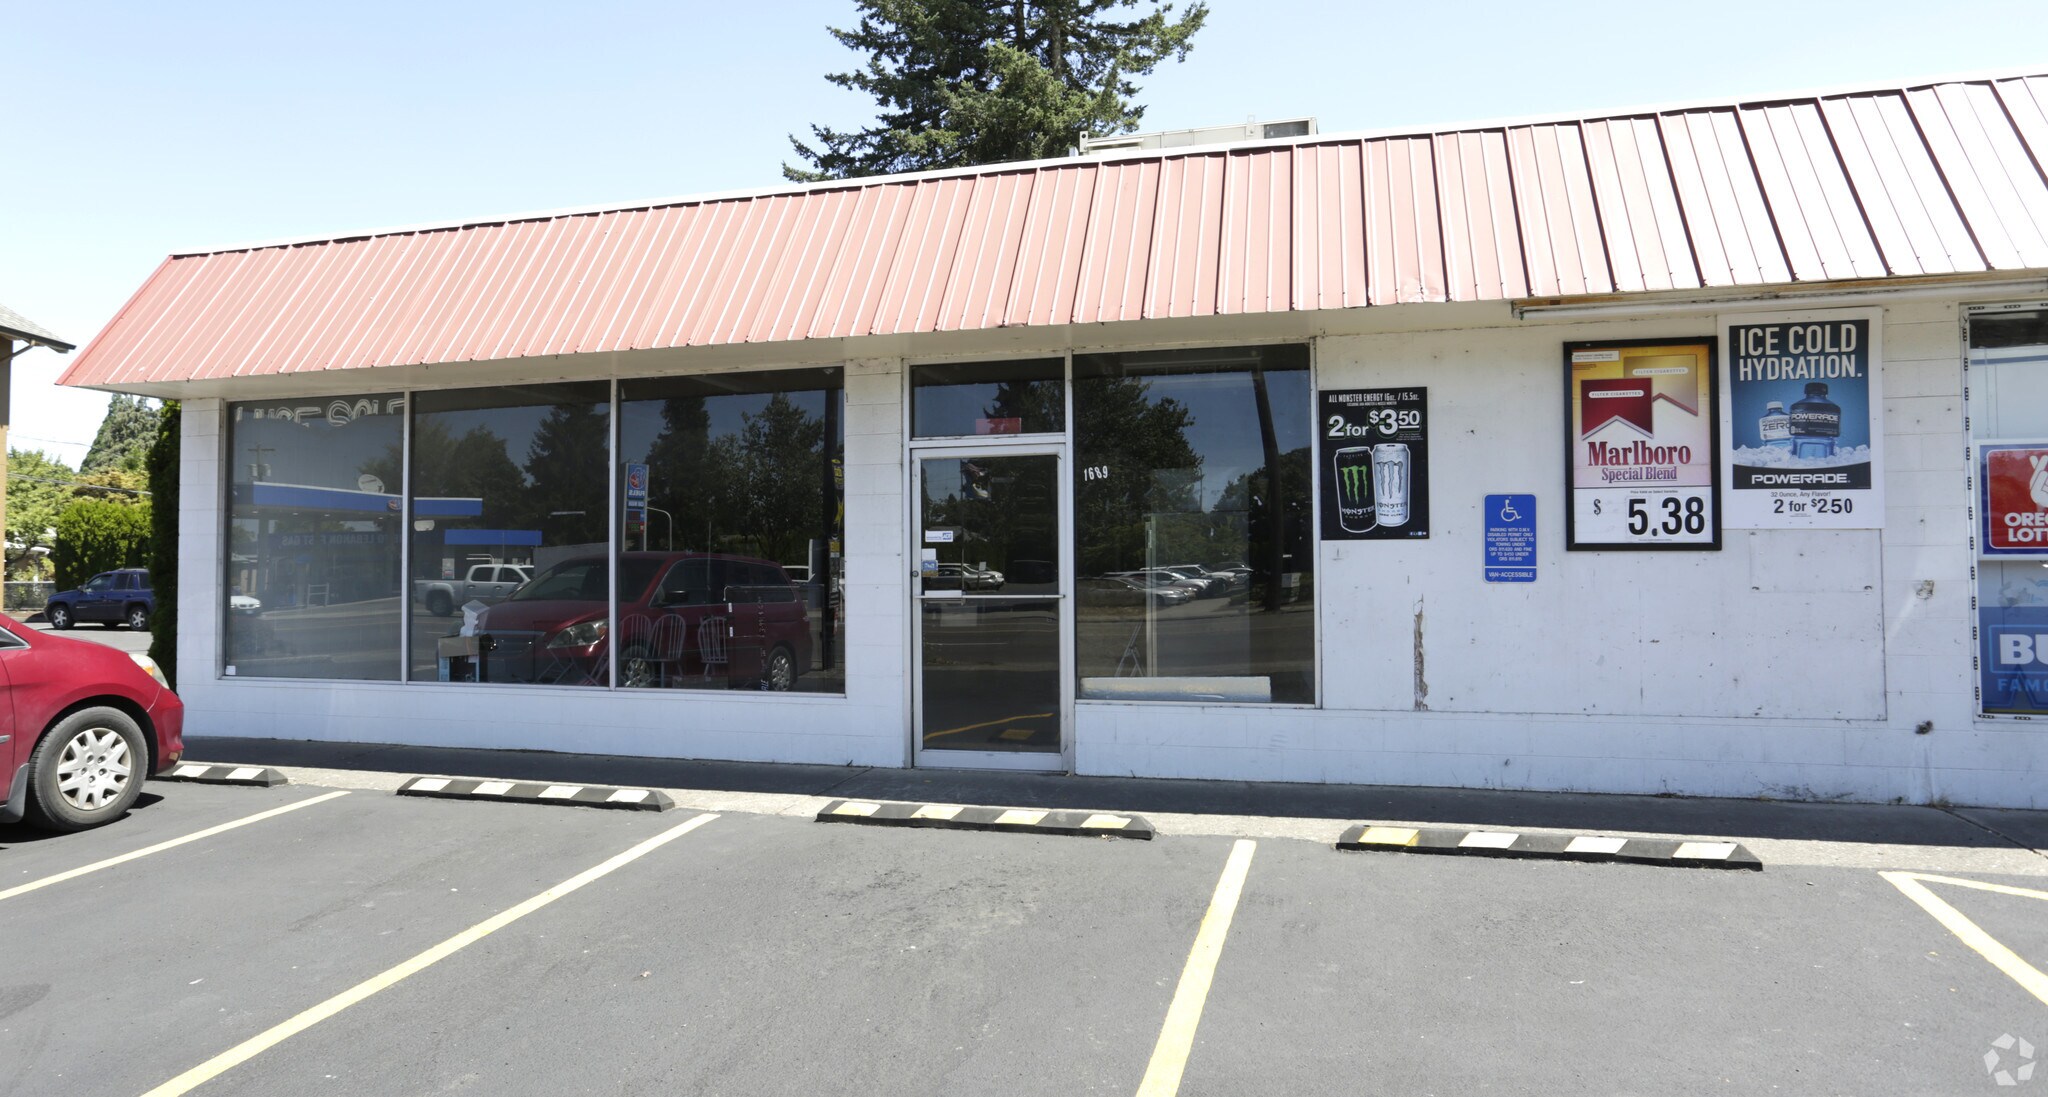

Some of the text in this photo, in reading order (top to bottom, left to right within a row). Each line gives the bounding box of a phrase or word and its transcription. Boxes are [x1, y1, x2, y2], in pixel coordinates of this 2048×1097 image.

[1739, 324, 1857, 356] ICE COLD
[1739, 354, 1862, 382] HYDRATION.
[1328, 395, 1338, 403] ALL
[1338, 394, 1362, 402] MONSTER
[1364, 393, 1383, 402] ENERGY
[1791, 413, 1838, 422] POWERADE
[1588, 440, 1691, 466] Marlboro
[1084, 465, 1108, 481] 1689
[1602, 466, 1677, 483] Special Blend
[1751, 473, 1847, 484] POWERADE
[1773, 499, 1784, 514] 2
[1788, 501, 1807, 512] for
[1593, 497, 1705, 537] $ 5.38
[2004, 512, 2048, 527] ORE
[2008, 528, 2048, 542] LOT
